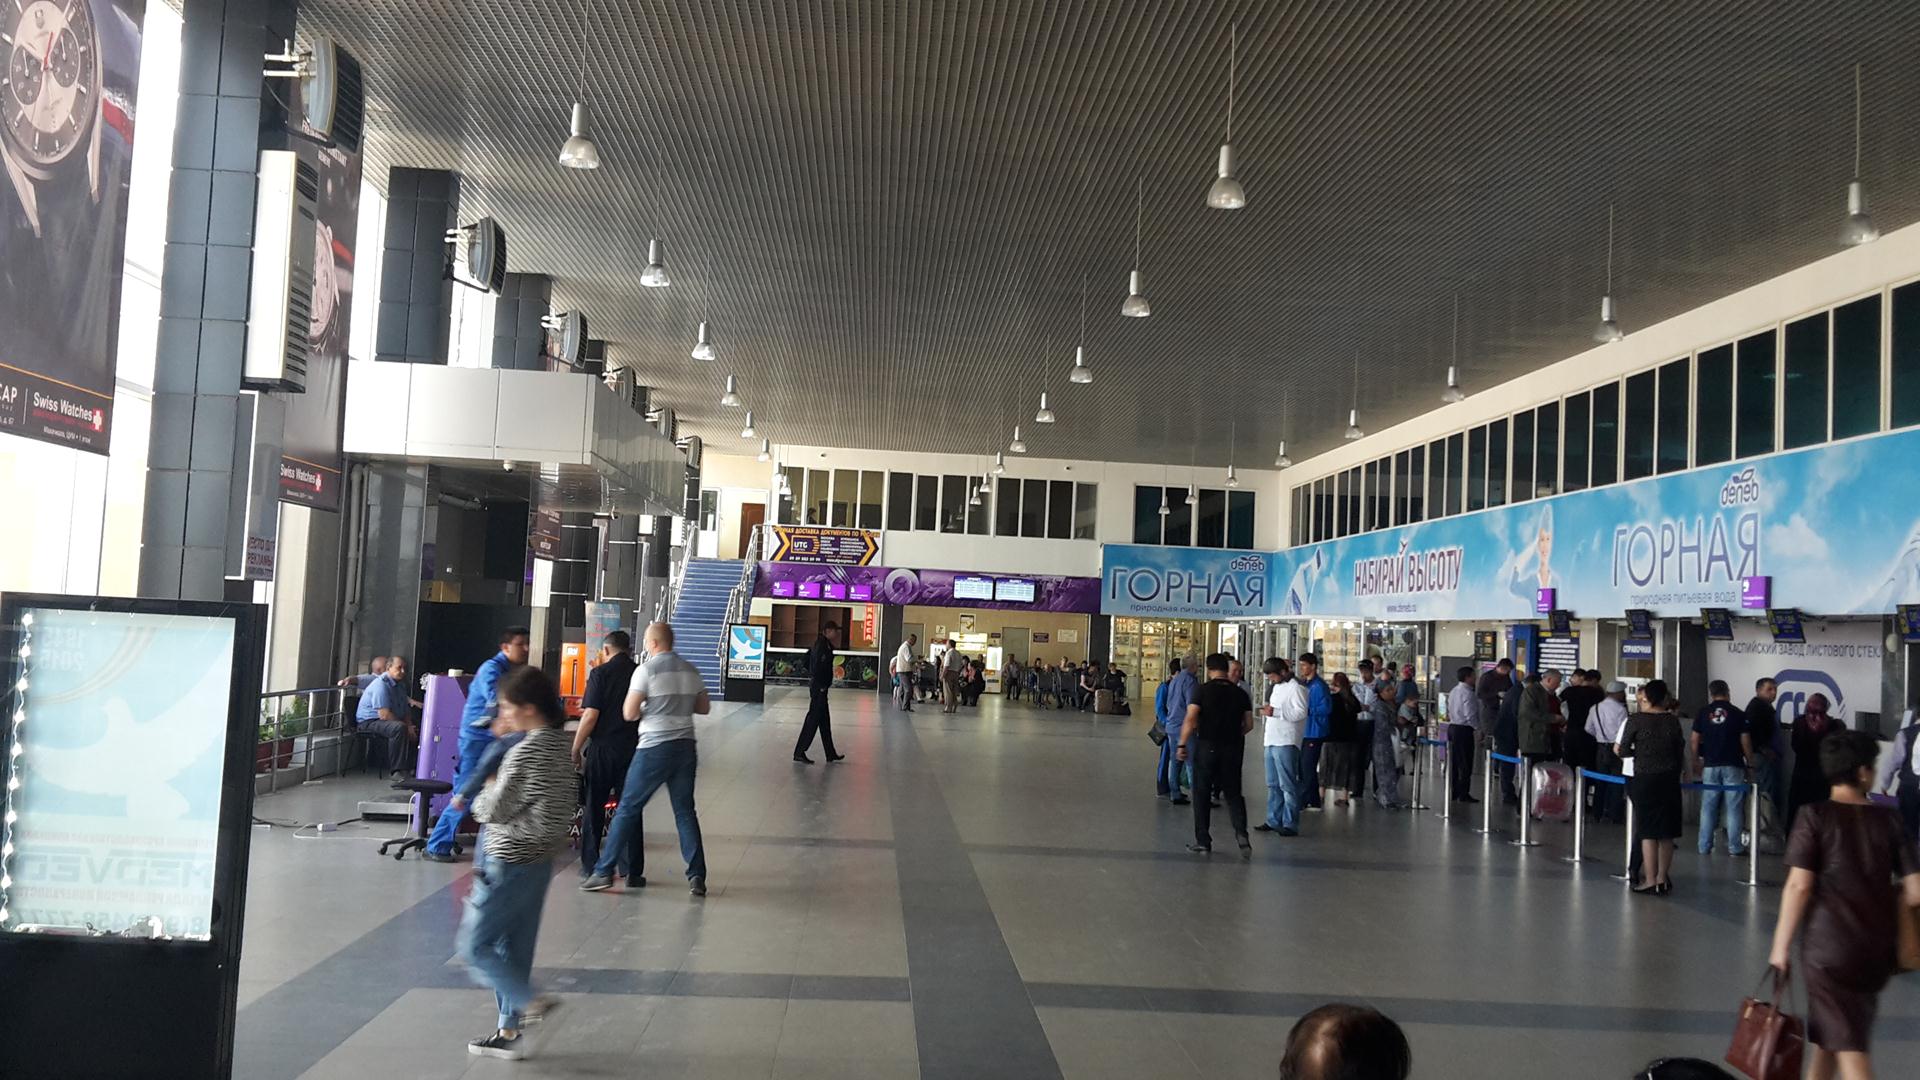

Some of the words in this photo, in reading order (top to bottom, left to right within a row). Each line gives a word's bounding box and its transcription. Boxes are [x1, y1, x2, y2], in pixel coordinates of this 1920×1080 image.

[33, 391, 58, 412] Swiss
[60, 399, 93, 421] Watches
[280, 463, 295, 479] Swiss
[295, 467, 316, 484] Watches
[1721, 479, 1759, 506] deneb
[793, 541, 808, 549] UTG
[1614, 513, 1759, 587] ГОРНАЯ
[1231, 558, 1265, 571] deneb
[1354, 542, 1406, 596] НАБИРАЙ
[1408, 549, 1463, 593] ВЫСОТУ
[1111, 568, 1265, 607] ГОРНАЯ
[1631, 592, 1672, 607] природная
[1673, 591, 1712, 604] питьевая
[1714, 591, 1736, 603] вода
[1130, 603, 1178, 613] природная
[1180, 606, 1220, 614] питьевая
[1222, 608, 1244, 616] вода
[865, 606, 873, 640] КАССА
[1727, 640, 1777, 655] КАСПИЙСКИЙ
[1778, 643, 1805, 657] ЗАВОД
[1805, 644, 1855, 658] ЛИСТОВОГО
